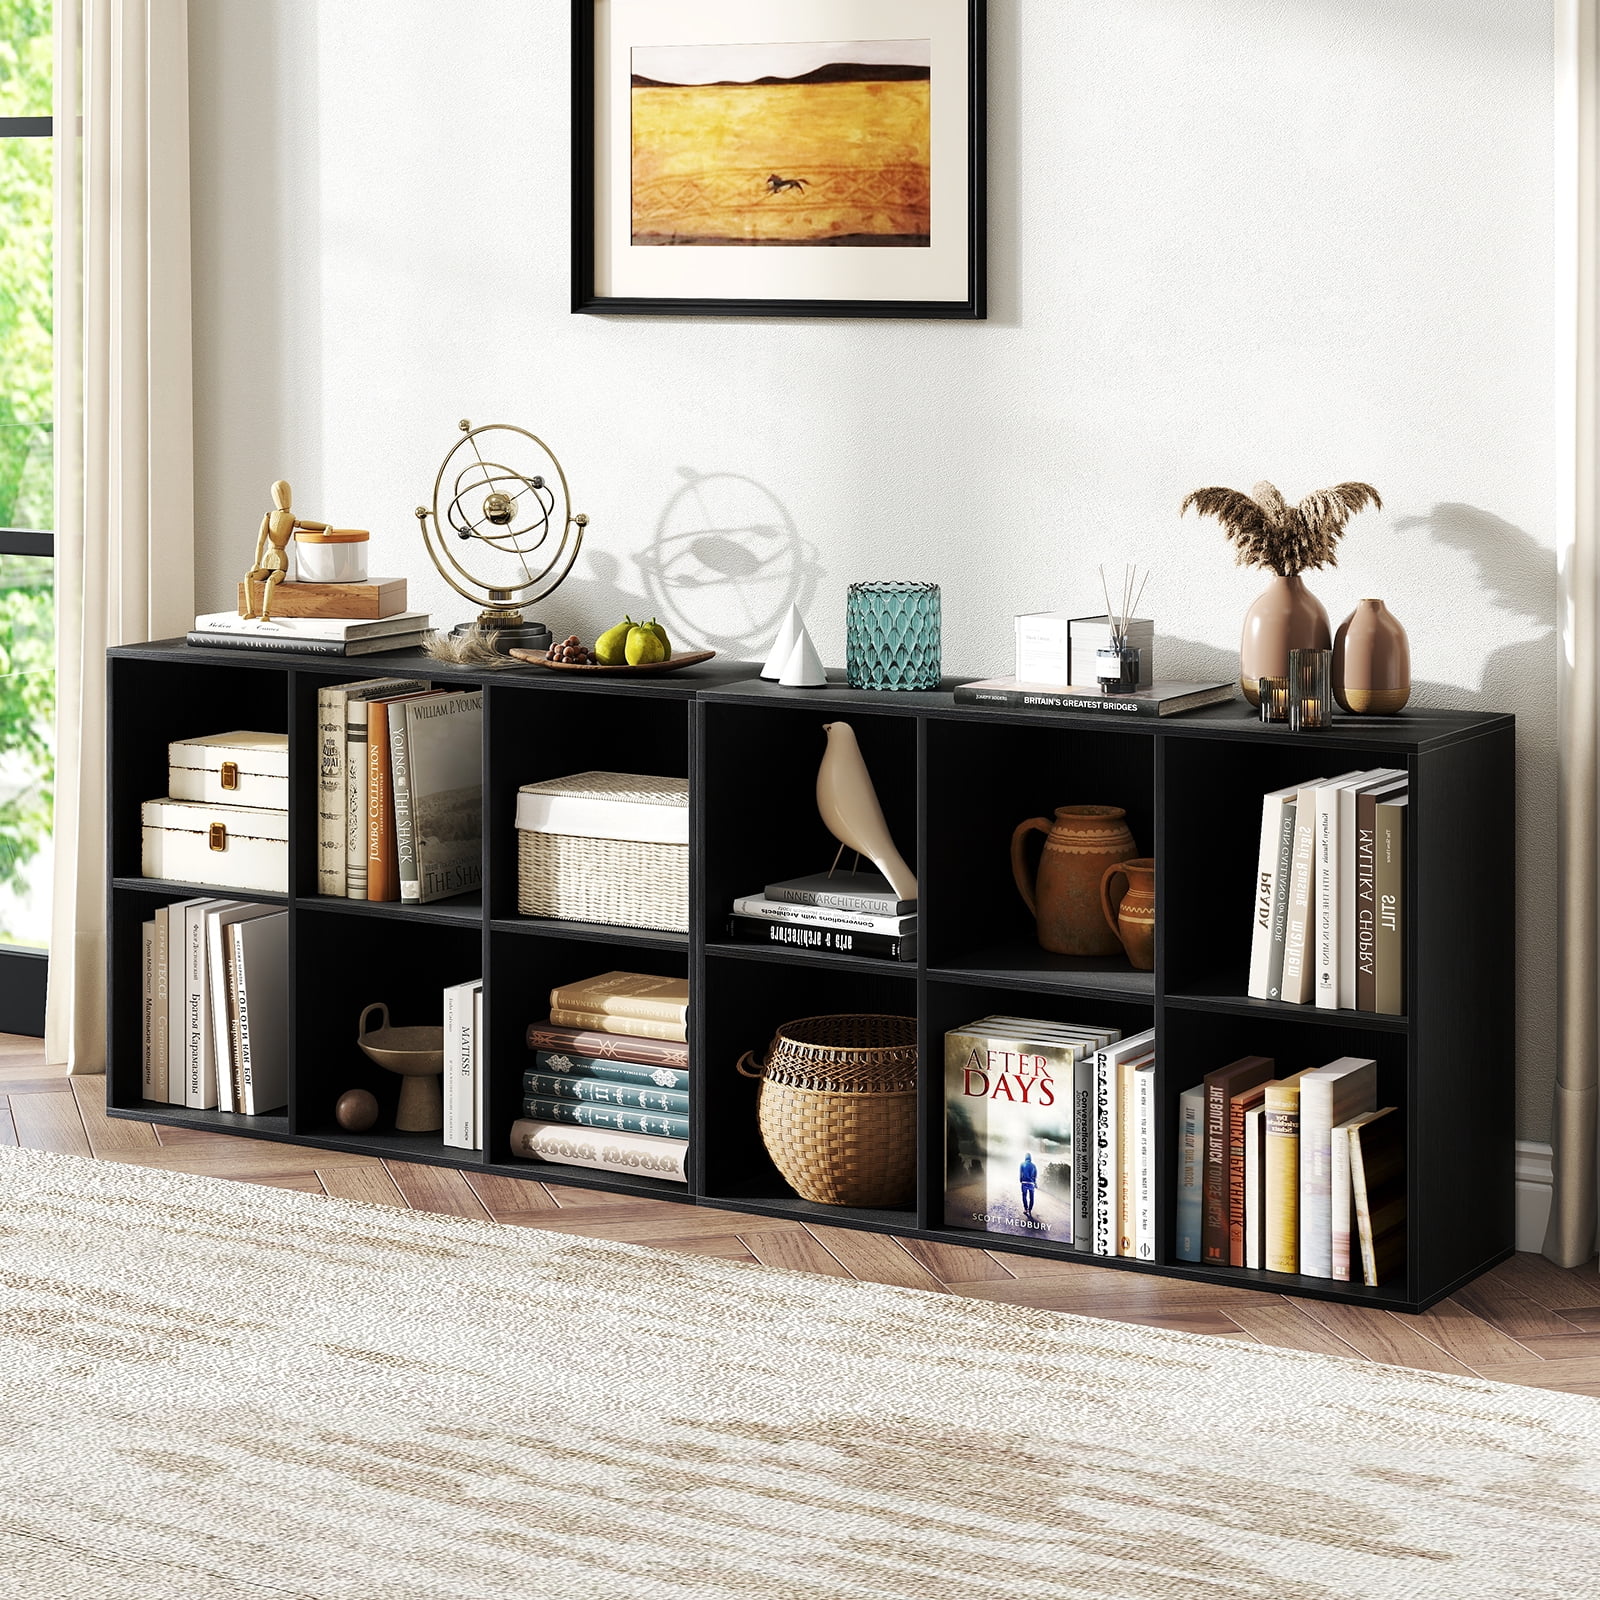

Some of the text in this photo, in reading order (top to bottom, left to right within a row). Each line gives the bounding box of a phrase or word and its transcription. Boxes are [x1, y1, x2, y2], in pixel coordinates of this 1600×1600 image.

[414, 702, 448, 720] WILLIAM
[450, 702, 456, 714] P.
[1024, 696, 1138, 712] BRITAIN'S GREATEST BRIDGES
[370, 744, 380, 863] JUMBO COLLECTION
[392, 727, 412, 864] YOUNG THE SHACK
[426, 871, 452, 894] THE
[456, 865, 482, 888] SHA
[762, 908, 798, 918] Architects
[784, 890, 888, 912] INNENARCHITEKTUR
[770, 925, 822, 947] architecture
[818, 916, 874, 928] Conversations
[836, 933, 852, 950] arts
[158, 962, 168, 1000] ГЕССЕ
[144, 998, 153, 1085] Маленькие женщины
[190, 994, 200, 1094] Братья Карамазовы
[239, 990, 252, 1087] ГОВОРИ КАК БОГ
[461, 1026, 470, 1077] MATISSE
[965, 1048, 1051, 1078] AFTER
[963, 1066, 1055, 1107] DAYS
[972, 1212, 1052, 1231] SCOTT MEDBURY
